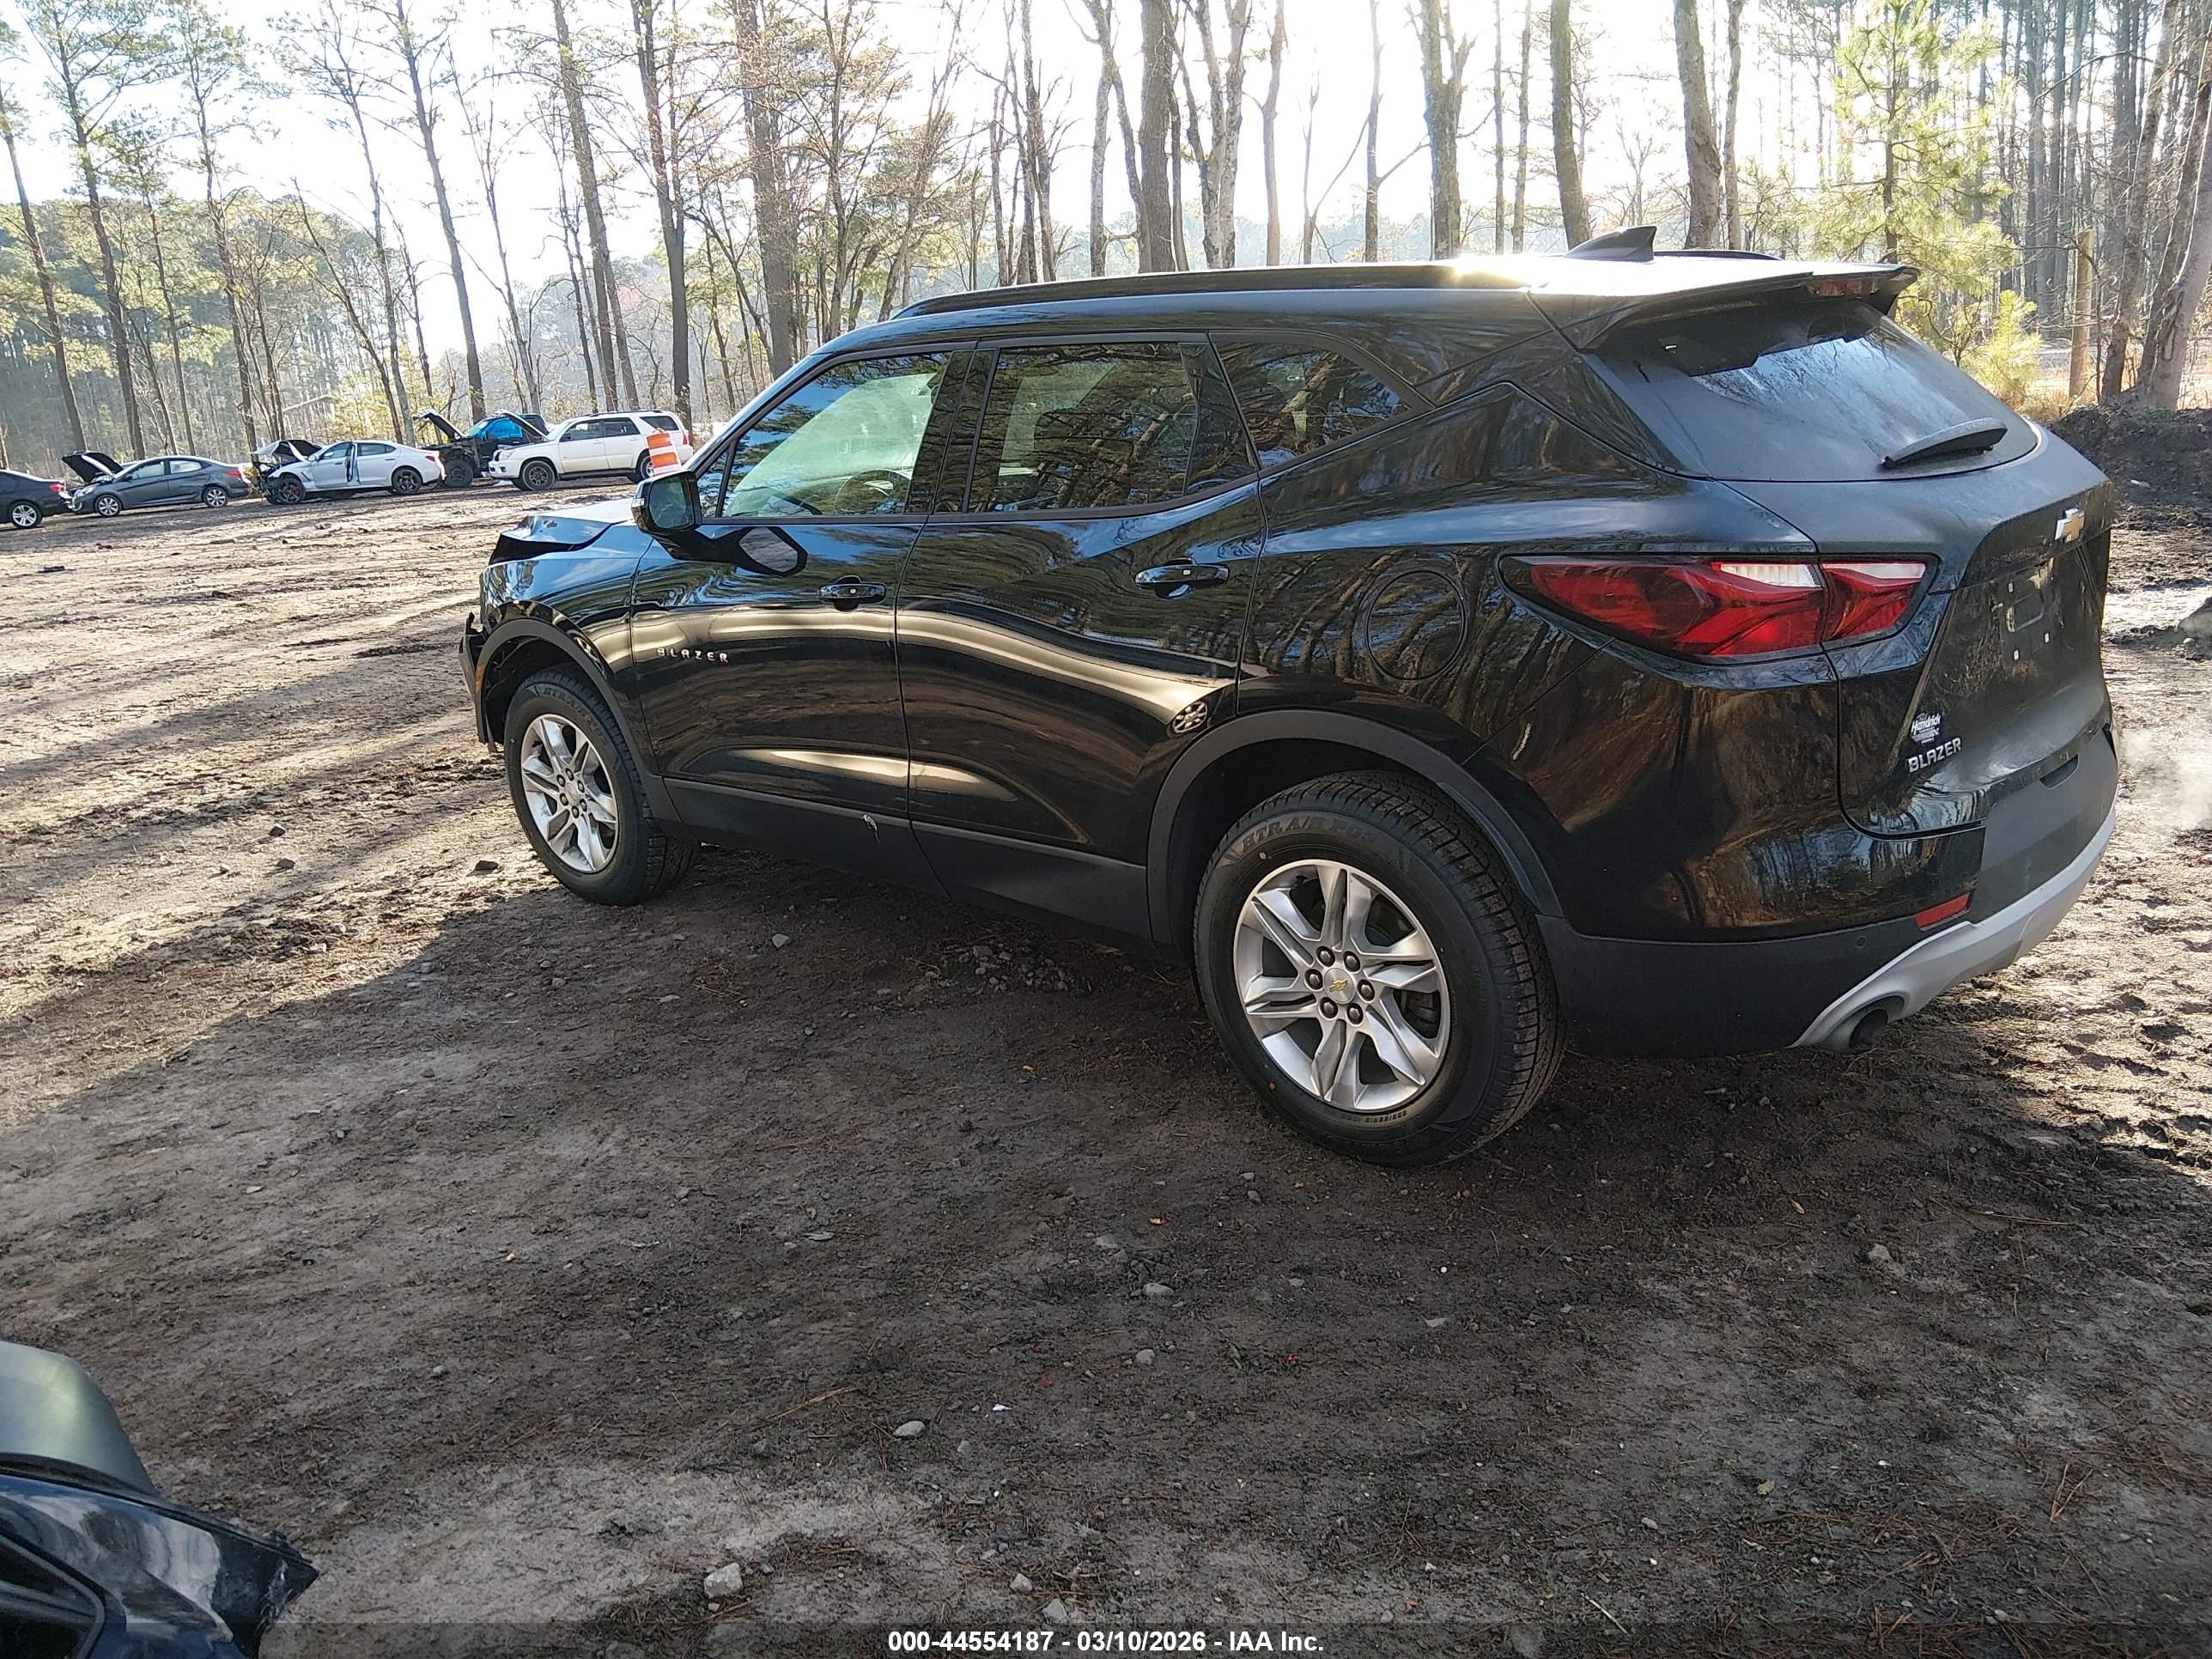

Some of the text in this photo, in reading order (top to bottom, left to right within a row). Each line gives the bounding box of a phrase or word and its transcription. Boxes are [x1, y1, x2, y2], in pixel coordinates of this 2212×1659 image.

[657, 647, 729, 664] BLAZER
[1907, 737, 1961, 773] BLAZER
[1241, 821, 1283, 854] HTR
